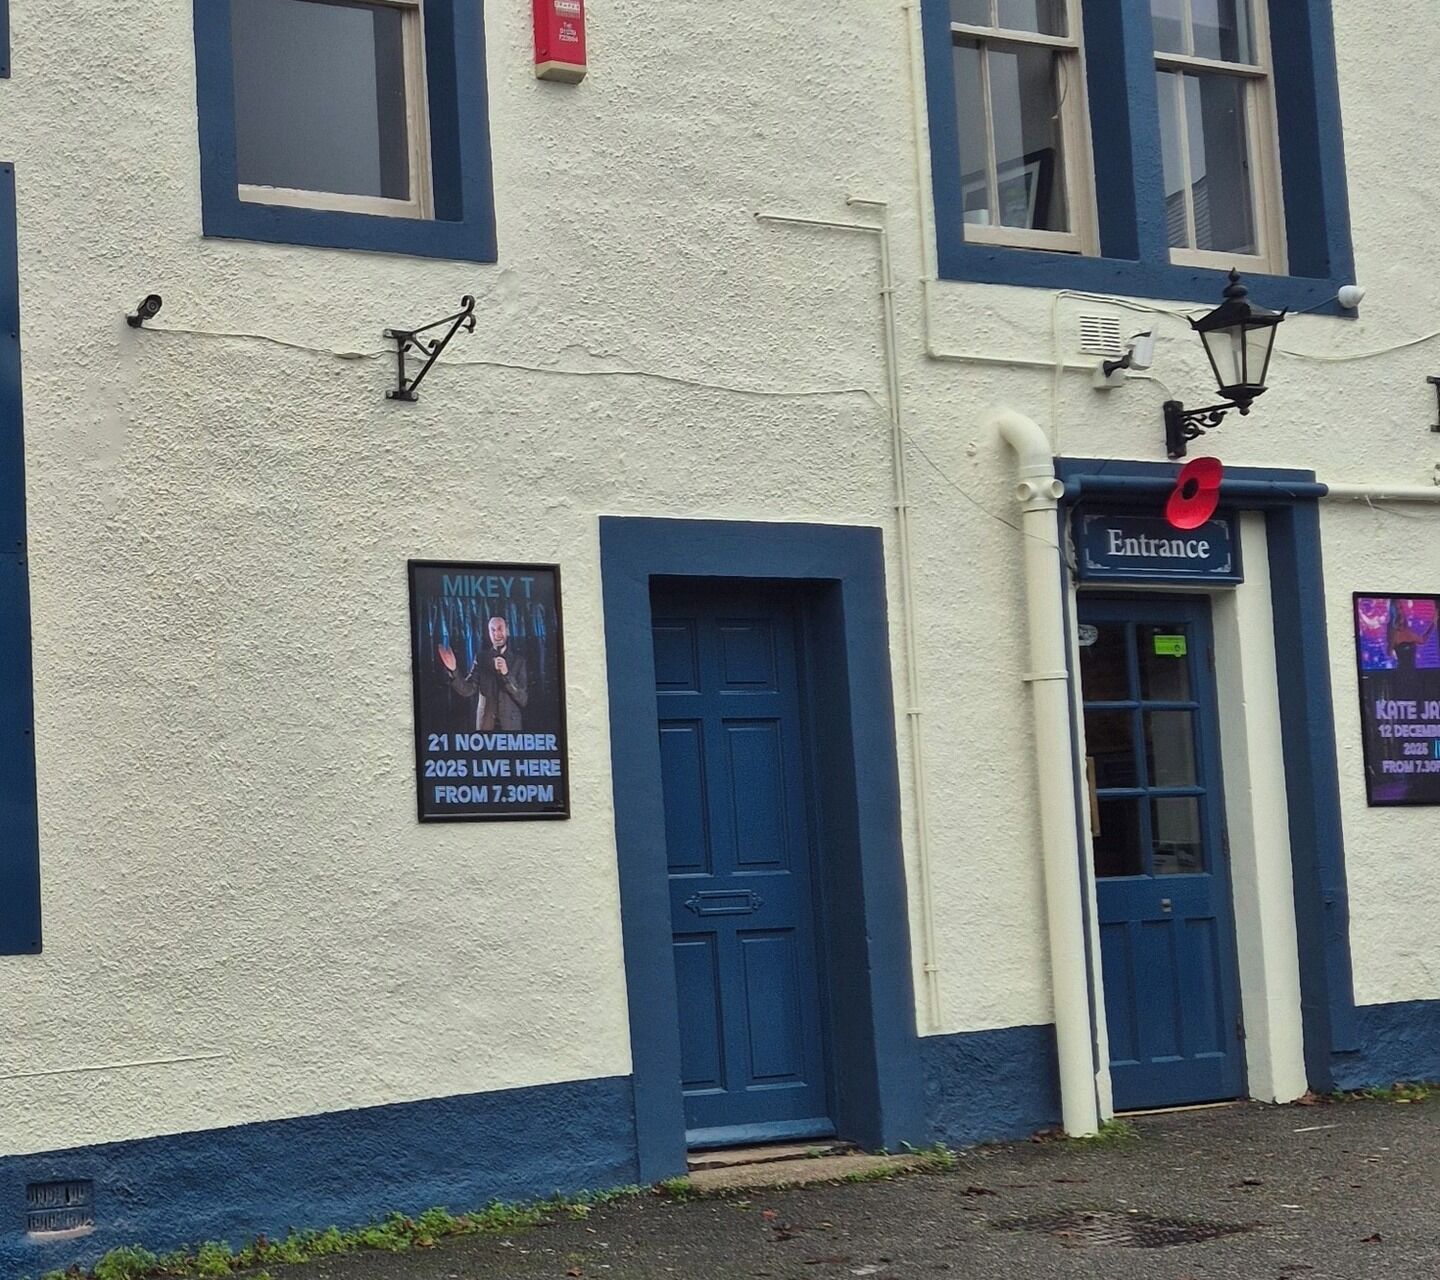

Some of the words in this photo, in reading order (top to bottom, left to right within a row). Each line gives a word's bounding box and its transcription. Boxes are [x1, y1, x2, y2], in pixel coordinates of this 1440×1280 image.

[1106, 528, 1210, 558] Entrance
[442, 575, 514, 598] MIKEY
[520, 577, 535, 599] T
[1375, 700, 1417, 720] KATE
[1378, 724, 1392, 738] 12
[428, 733, 449, 751] 21
[455, 733, 558, 751] NOVEMBER
[424, 759, 468, 777] 2025
[472, 759, 510, 777] LIVE
[515, 759, 561, 777] HERE
[1382, 760, 1414, 774] FROM
[434, 785, 488, 803] FROM
[492, 784, 554, 803] 7.30PM
